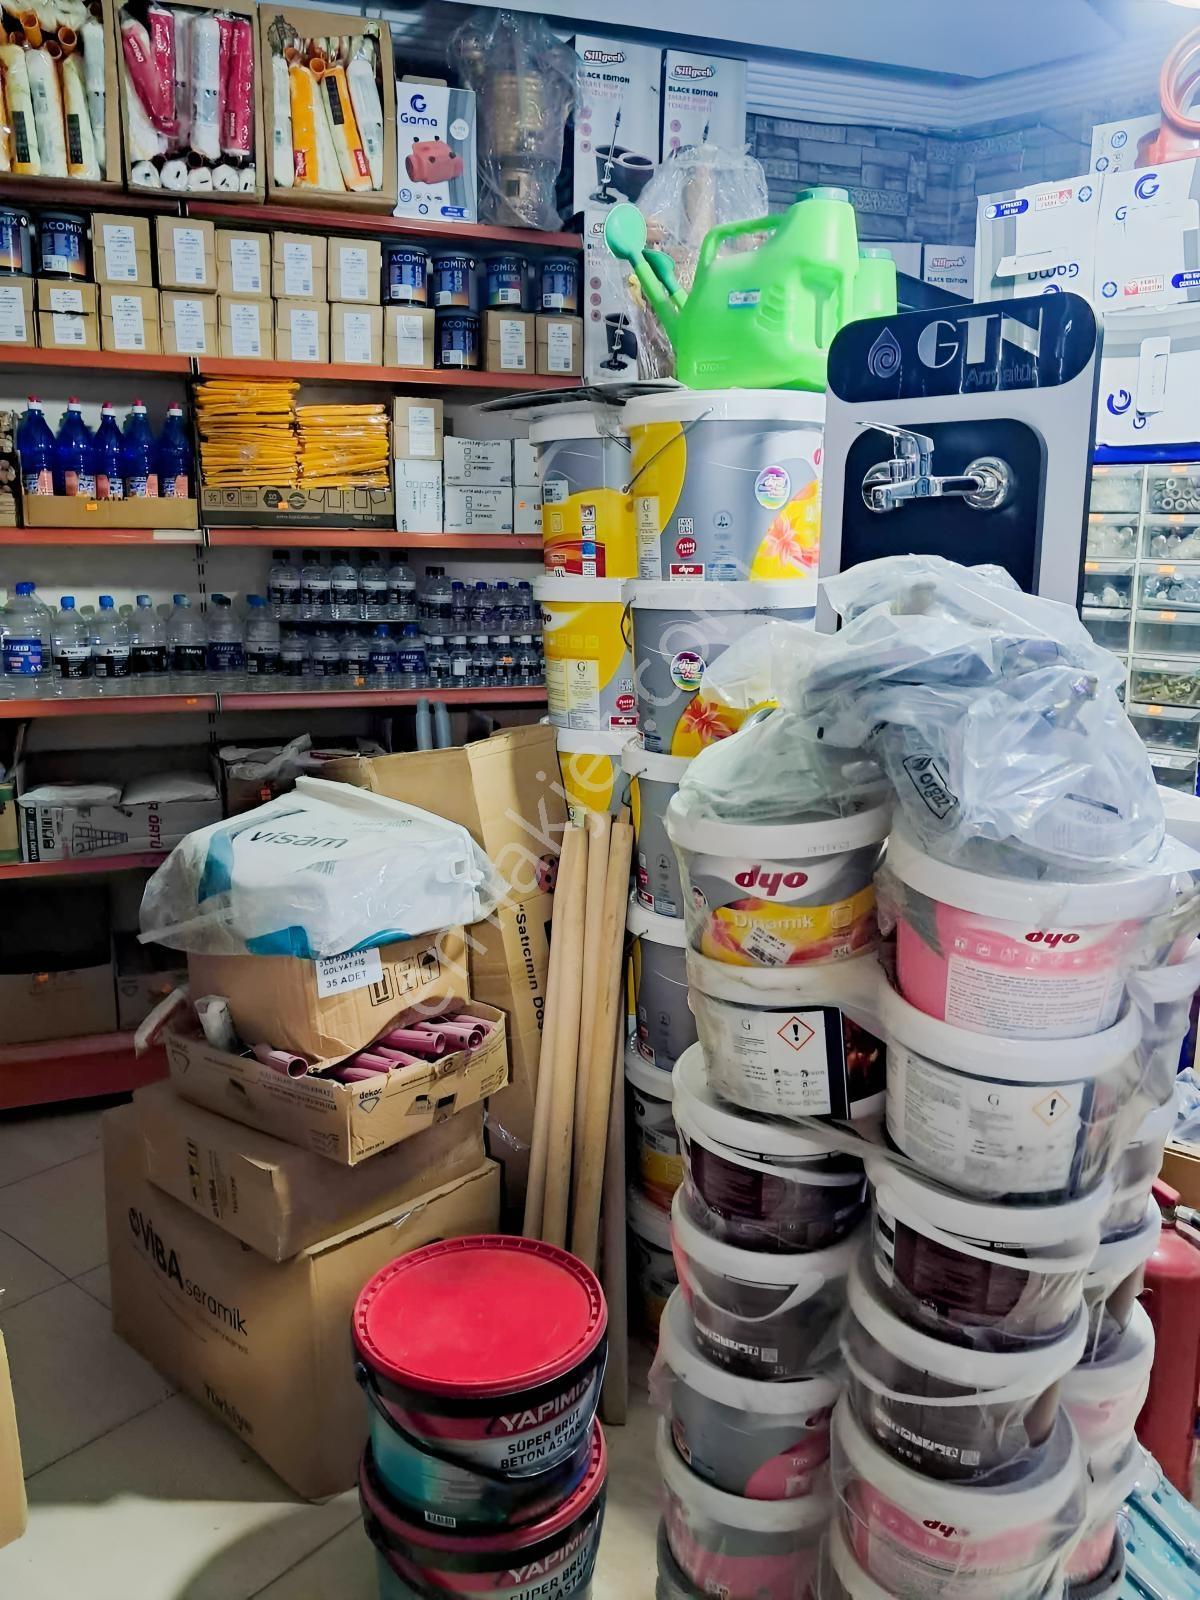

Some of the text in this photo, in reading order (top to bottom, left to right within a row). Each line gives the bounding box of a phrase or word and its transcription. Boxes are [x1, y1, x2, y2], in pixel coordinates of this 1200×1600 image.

[602, 74, 630, 84] EDITION
[668, 85, 718, 98] BLACK EDITION
[400, 112, 438, 128] Gama
[917, 307, 1043, 369] GTN
[678, 564, 695, 575] dyo
[250, 831, 349, 849] visam
[734, 864, 809, 897] dyo
[1024, 929, 1080, 948] dyo
[326, 970, 367, 988] 35 ADET
[185, 1278, 248, 1336] seramik
[508, 1407, 580, 1455] SÜPER BRUT
[501, 1446, 545, 1470] BETON
